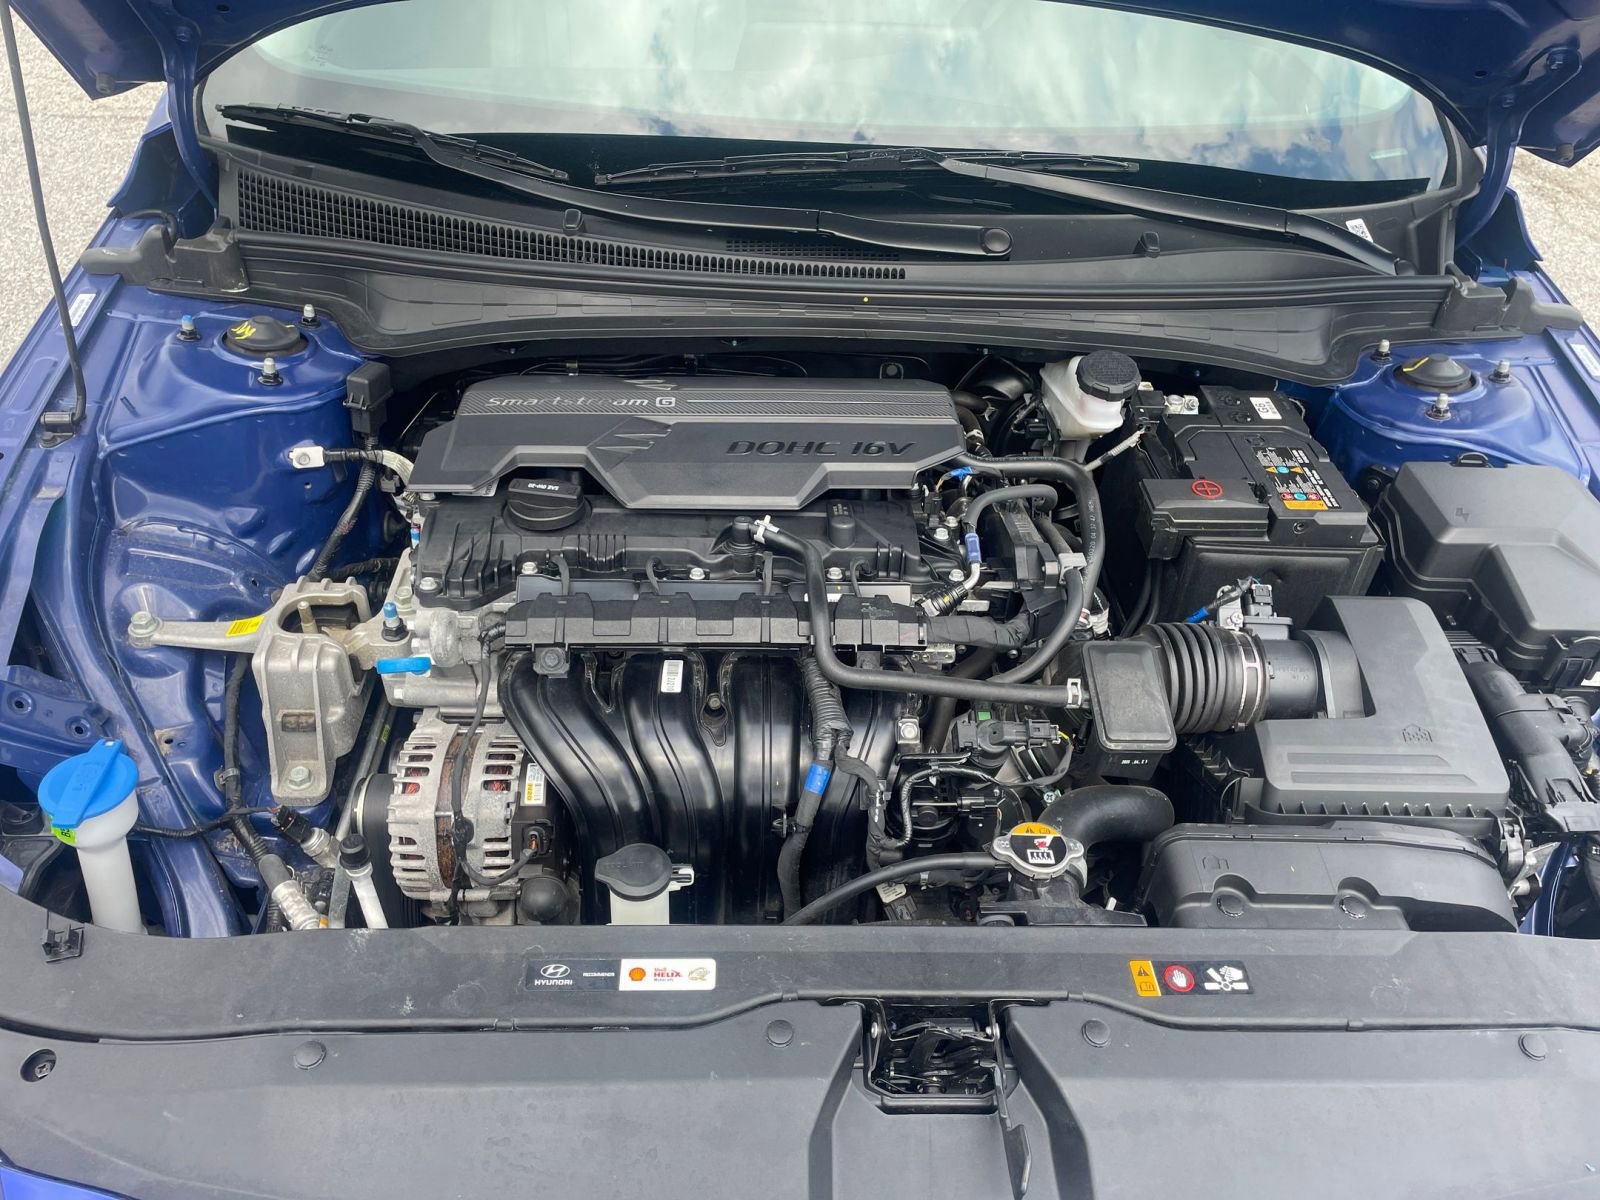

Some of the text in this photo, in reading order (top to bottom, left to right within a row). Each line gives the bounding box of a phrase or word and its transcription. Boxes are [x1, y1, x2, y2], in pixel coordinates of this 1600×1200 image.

[486, 396, 649, 407] Smartstream
[726, 441, 915, 456] DOHC 16V
